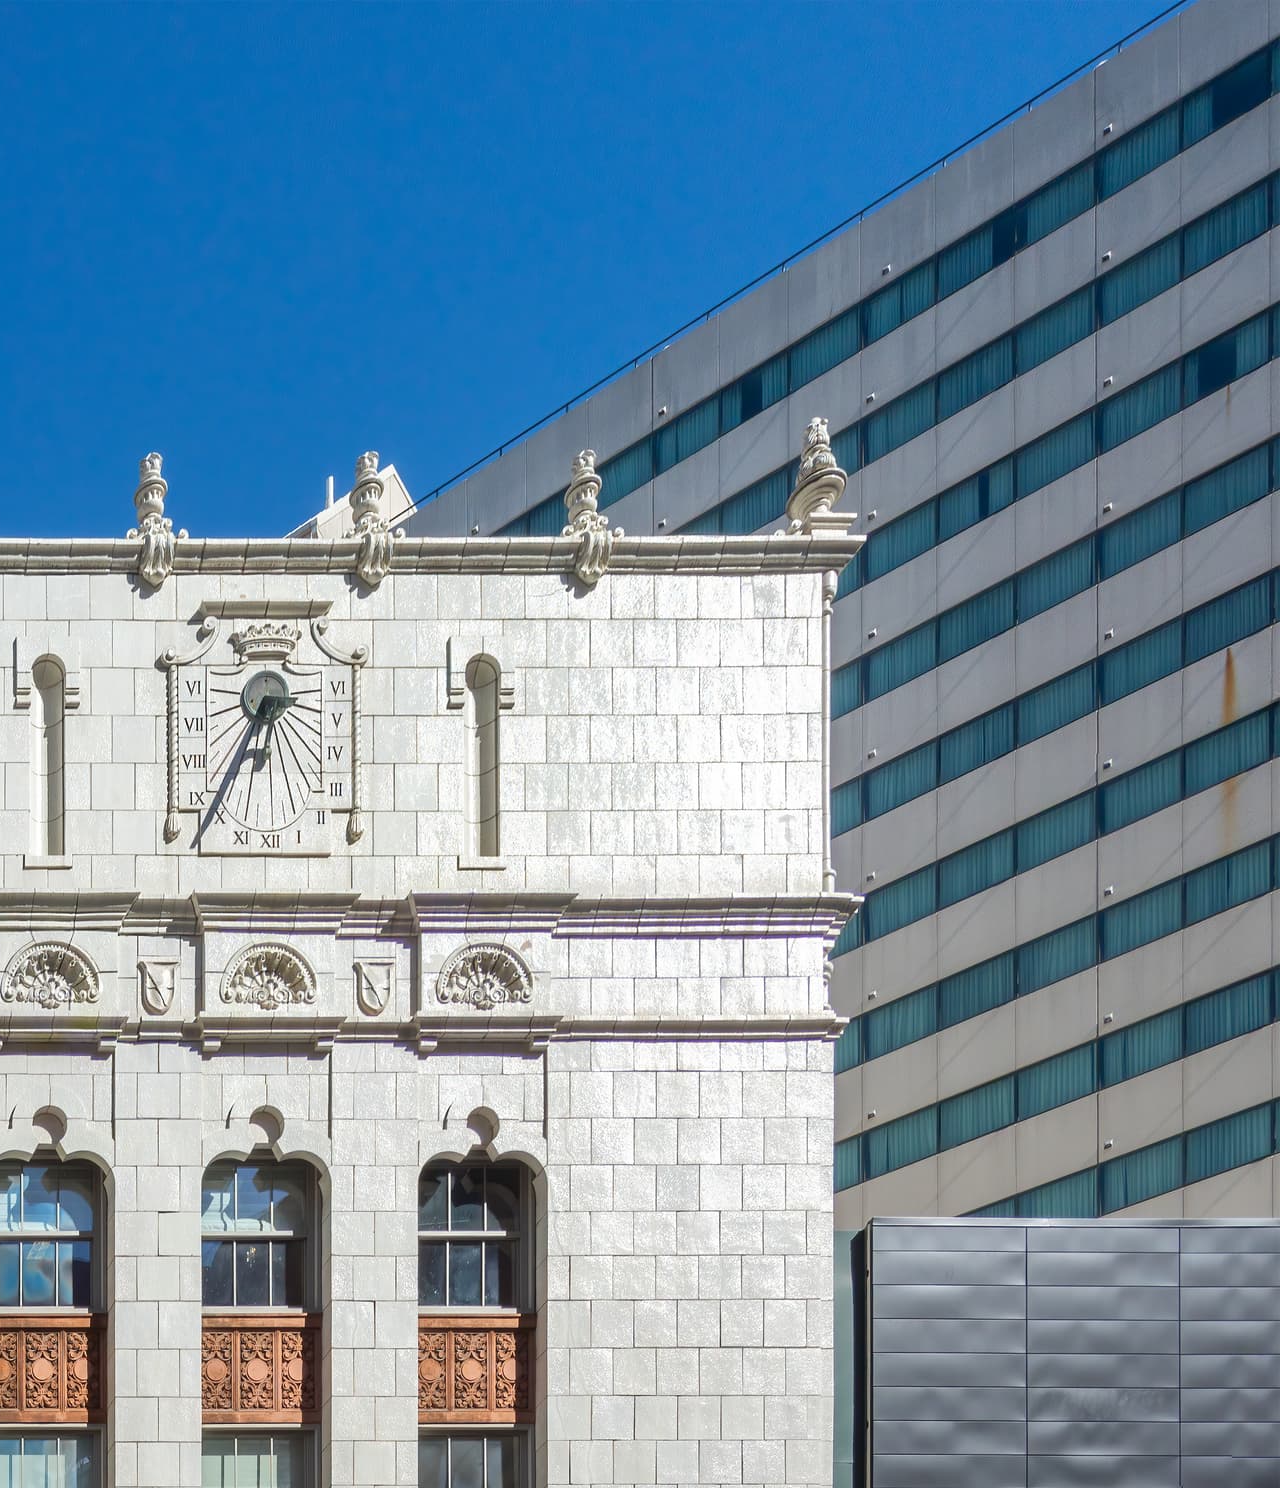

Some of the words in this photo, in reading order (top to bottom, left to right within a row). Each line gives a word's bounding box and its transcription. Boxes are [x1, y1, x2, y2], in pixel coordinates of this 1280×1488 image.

[185, 681, 201, 696] VI
[330, 681, 345, 696] VI
[184, 718, 203, 732] VII
[332, 713, 342, 728] V
[328, 746, 343, 760] IV
[182, 754, 206, 768] VIII
[330, 784, 342, 797] III
[189, 792, 204, 805] IX
[214, 811, 226, 824] X
[317, 811, 325, 824] II
[234, 831, 249, 845] XI
[261, 834, 280, 848] XII
[296, 831, 301, 844] I
